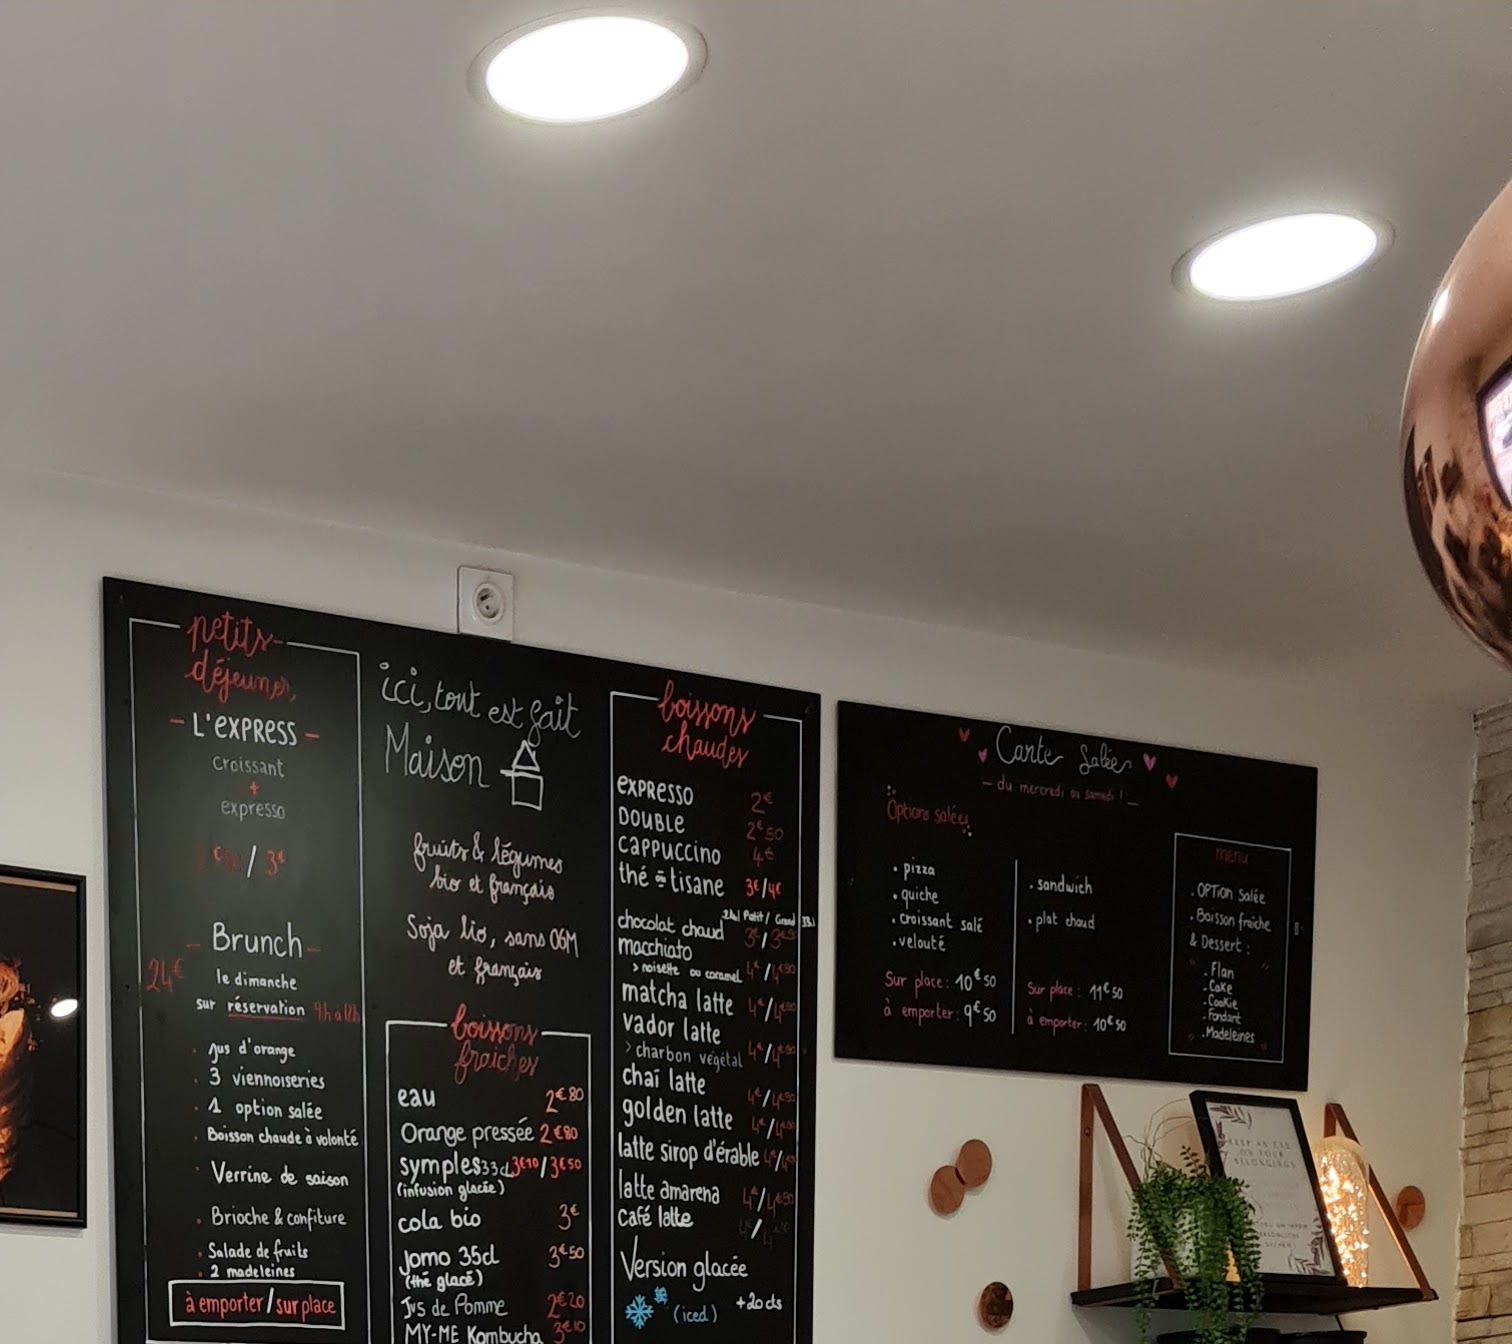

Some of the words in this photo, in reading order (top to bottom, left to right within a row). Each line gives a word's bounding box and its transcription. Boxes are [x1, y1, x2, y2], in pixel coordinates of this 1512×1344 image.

[488, 697, 524, 730] est
[658, 679, 757, 737] boissons
[385, 722, 491, 789] Maison
[661, 720, 749, 768] chaudes
[996, 725, 1064, 766] Carte
[212, 754, 285, 778] croissant
[221, 799, 286, 822] expresso
[491, 836, 564, 879] légumes
[903, 857, 935, 881] pizza
[488, 872, 555, 905] français
[619, 860, 649, 888] thé
[670, 866, 725, 898] tisane
[1037, 874, 1093, 895] sandwich
[901, 886, 939, 909] quiche
[618, 908, 677, 934] chocolat
[682, 917, 724, 941] chaud
[899, 909, 952, 930] croissant
[960, 917, 983, 933] salé
[1036, 912, 1058, 933] plat
[1065, 911, 1095, 930] chaud
[1196, 907, 1235, 926] Boisson
[213, 921, 303, 958] Brunch
[406, 913, 450, 952] Soja
[504, 927, 546, 947] sans
[550, 927, 580, 959] OGM
[899, 935, 946, 952] velouté
[1201, 934, 1242, 953] Dessert
[618, 937, 692, 961] macchiato
[234, 971, 298, 991] dimanche
[474, 955, 543, 986] français
[885, 971, 908, 988] Sur
[1211, 961, 1234, 979] Flan
[622, 979, 687, 1010] matcha
[696, 987, 734, 1016] latte
[1209, 979, 1233, 995] Cake
[227, 996, 306, 1016] réservation
[1208, 994, 1238, 1010] Cookie
[450, 1002, 539, 1047] boissons
[623, 1012, 675, 1038] vador
[683, 1017, 721, 1045] latte
[1208, 1010, 1242, 1025] Fondant
[1206, 1026, 1255, 1043] Madeleines
[238, 1037, 296, 1064] d'orange
[636, 1040, 691, 1064] charbon
[232, 1066, 326, 1090] viennoiseries
[669, 1067, 706, 1095] latte
[235, 1098, 283, 1122] option
[288, 1102, 323, 1120] salée
[397, 1087, 436, 1108] eau
[622, 1095, 686, 1127] golden
[693, 1104, 733, 1130] latte
[207, 1124, 254, 1143] Boisson
[258, 1127, 302, 1144] chaude
[316, 1128, 359, 1147] volonté
[400, 1122, 467, 1148] Orange
[471, 1116, 535, 1149] pressée
[618, 1132, 654, 1162] latte
[660, 1140, 698, 1170] sirop
[704, 1138, 760, 1167] d'érable
[211, 1160, 273, 1184] Verrine
[305, 1170, 349, 1187] saison
[399, 1150, 482, 1184] symples
[618, 1168, 655, 1201] latte
[660, 1180, 720, 1205] amarena
[211, 1204, 271, 1226] Brioche
[287, 1207, 348, 1232] confiture
[398, 1208, 443, 1233] cola
[450, 1206, 481, 1229] bio
[658, 1205, 694, 1228] latte
[208, 1241, 253, 1260] Salade
[273, 1238, 309, 1263] fruits
[620, 1234, 687, 1282] Version
[692, 1250, 749, 1292] glacée
[227, 1263, 295, 1279] madeleines
[199, 1291, 264, 1319] emporter
[301, 1294, 337, 1323] place
[454, 1292, 509, 1317] Pomme
